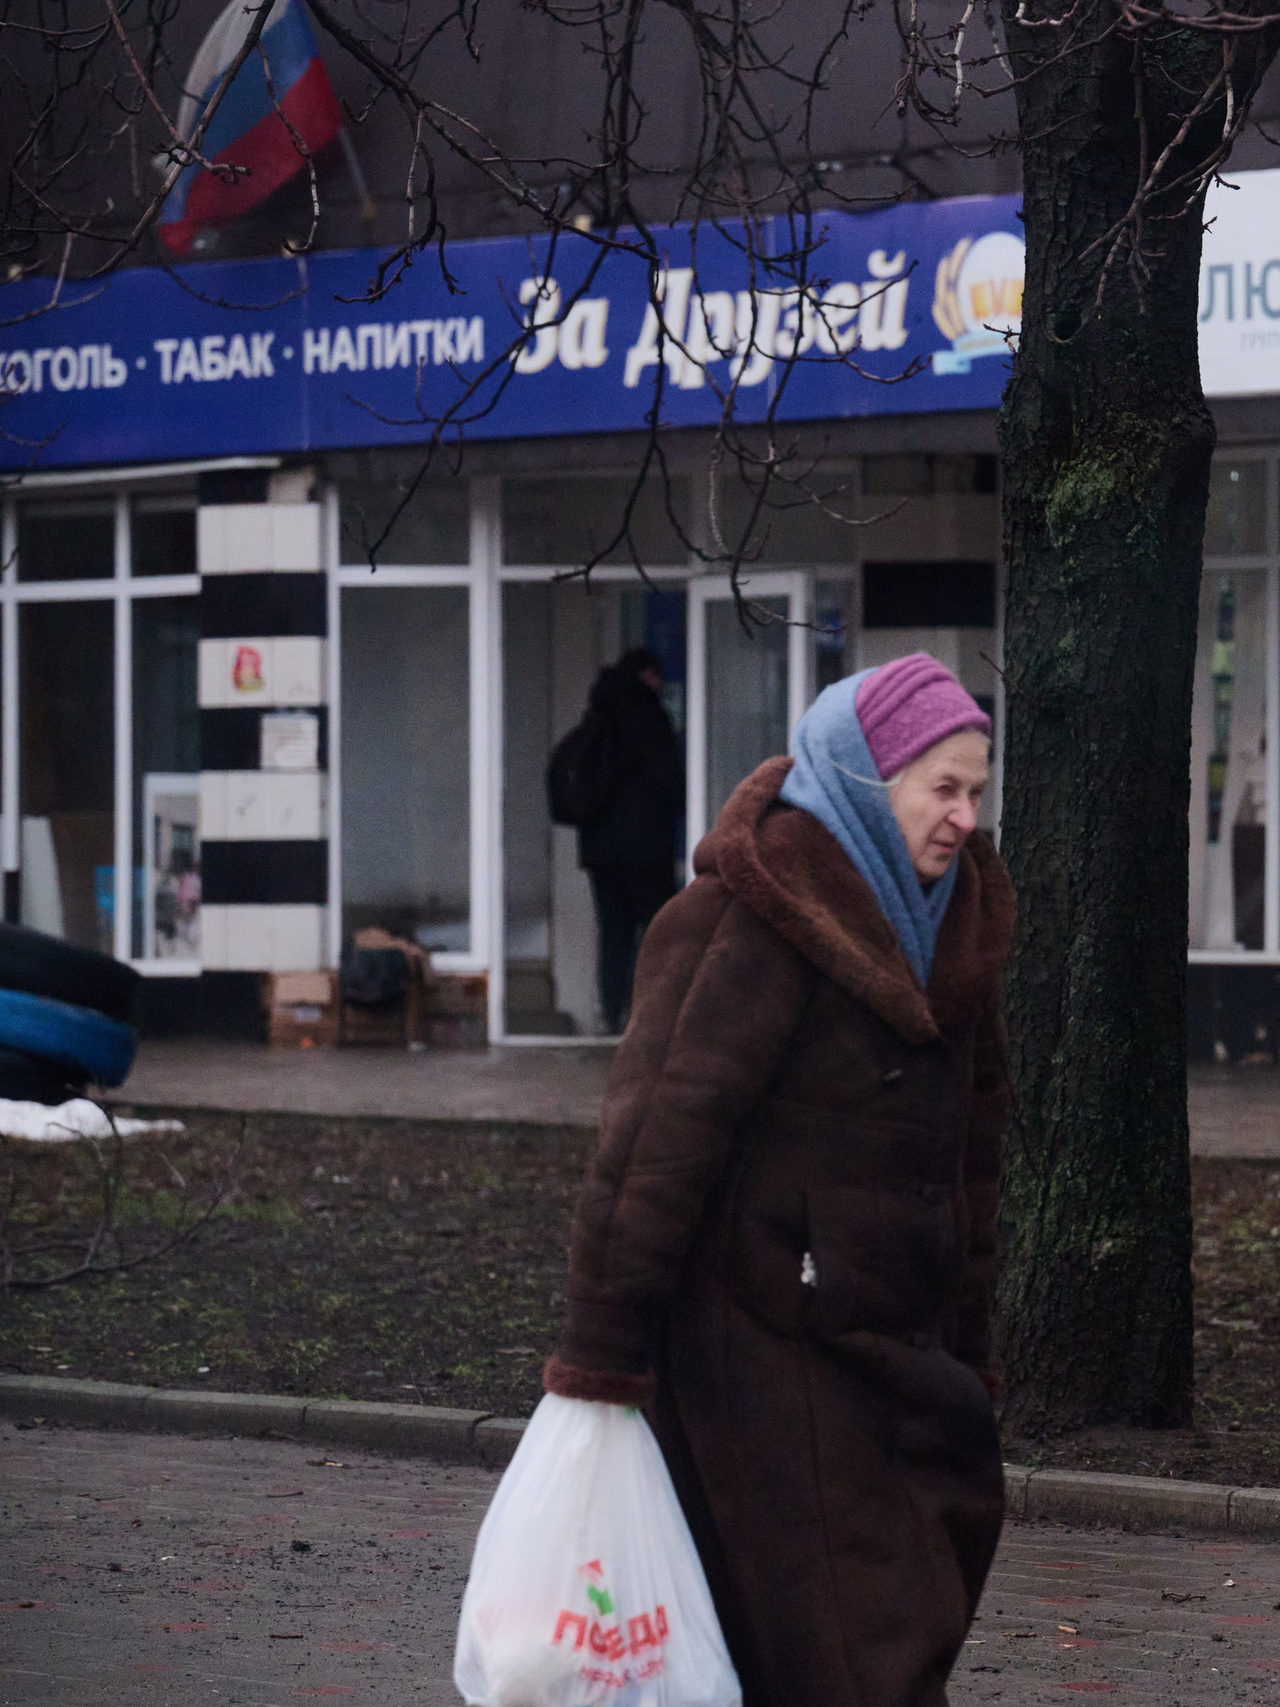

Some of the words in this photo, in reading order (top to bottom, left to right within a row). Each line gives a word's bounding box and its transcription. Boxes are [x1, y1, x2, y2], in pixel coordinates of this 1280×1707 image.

[155, 332, 276, 385] ТАБАК
[303, 316, 486, 375] НАПИТКИ
[510, 276, 611, 375] За
[623, 249, 910, 390] Друзей
